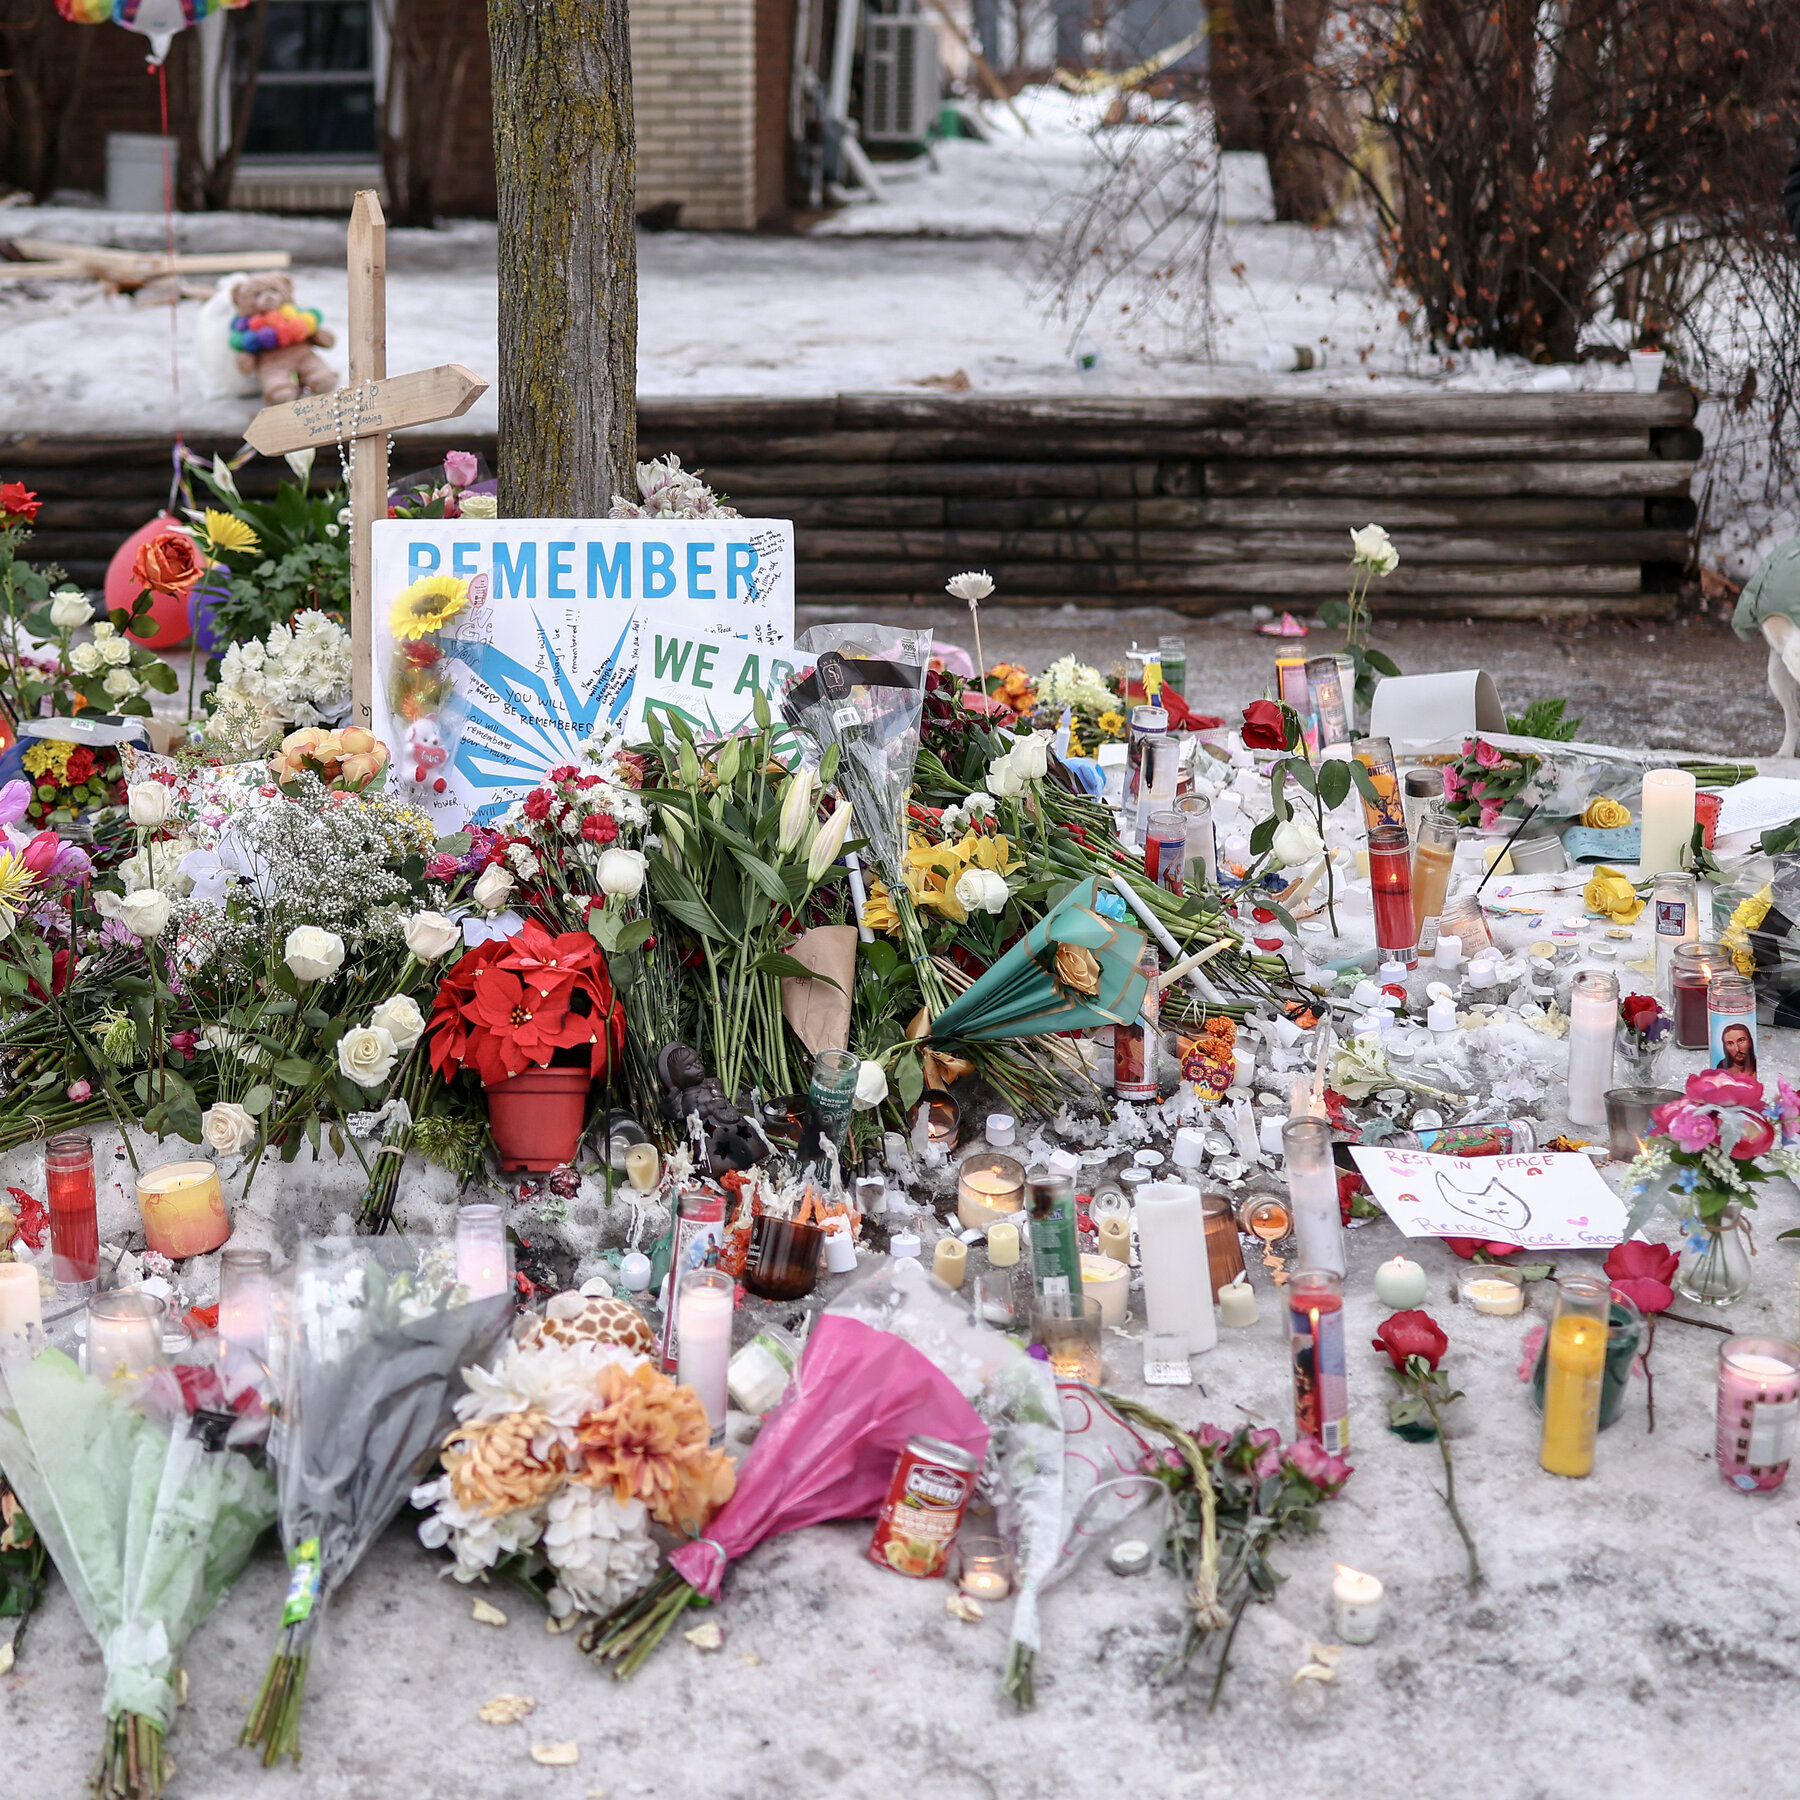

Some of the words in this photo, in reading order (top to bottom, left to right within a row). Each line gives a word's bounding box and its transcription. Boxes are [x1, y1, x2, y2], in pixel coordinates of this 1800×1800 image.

[408, 542, 760, 599] REMEMBER
[536, 628, 545, 650] will
[552, 628, 560, 640] be
[535, 653, 548, 673] You
[654, 634, 720, 690] WE
[733, 653, 816, 704] AR
[502, 702, 518, 716] BE
[505, 688, 532, 703] YOU
[537, 696, 566, 711] WILL
[484, 722, 499, 733] will
[519, 714, 595, 735] REMEMBERED
[479, 806, 496, 817] will
[1385, 1150, 1434, 1167] REST
[1453, 1161, 1472, 1170] IN
[1495, 1155, 1556, 1171] PEACE
